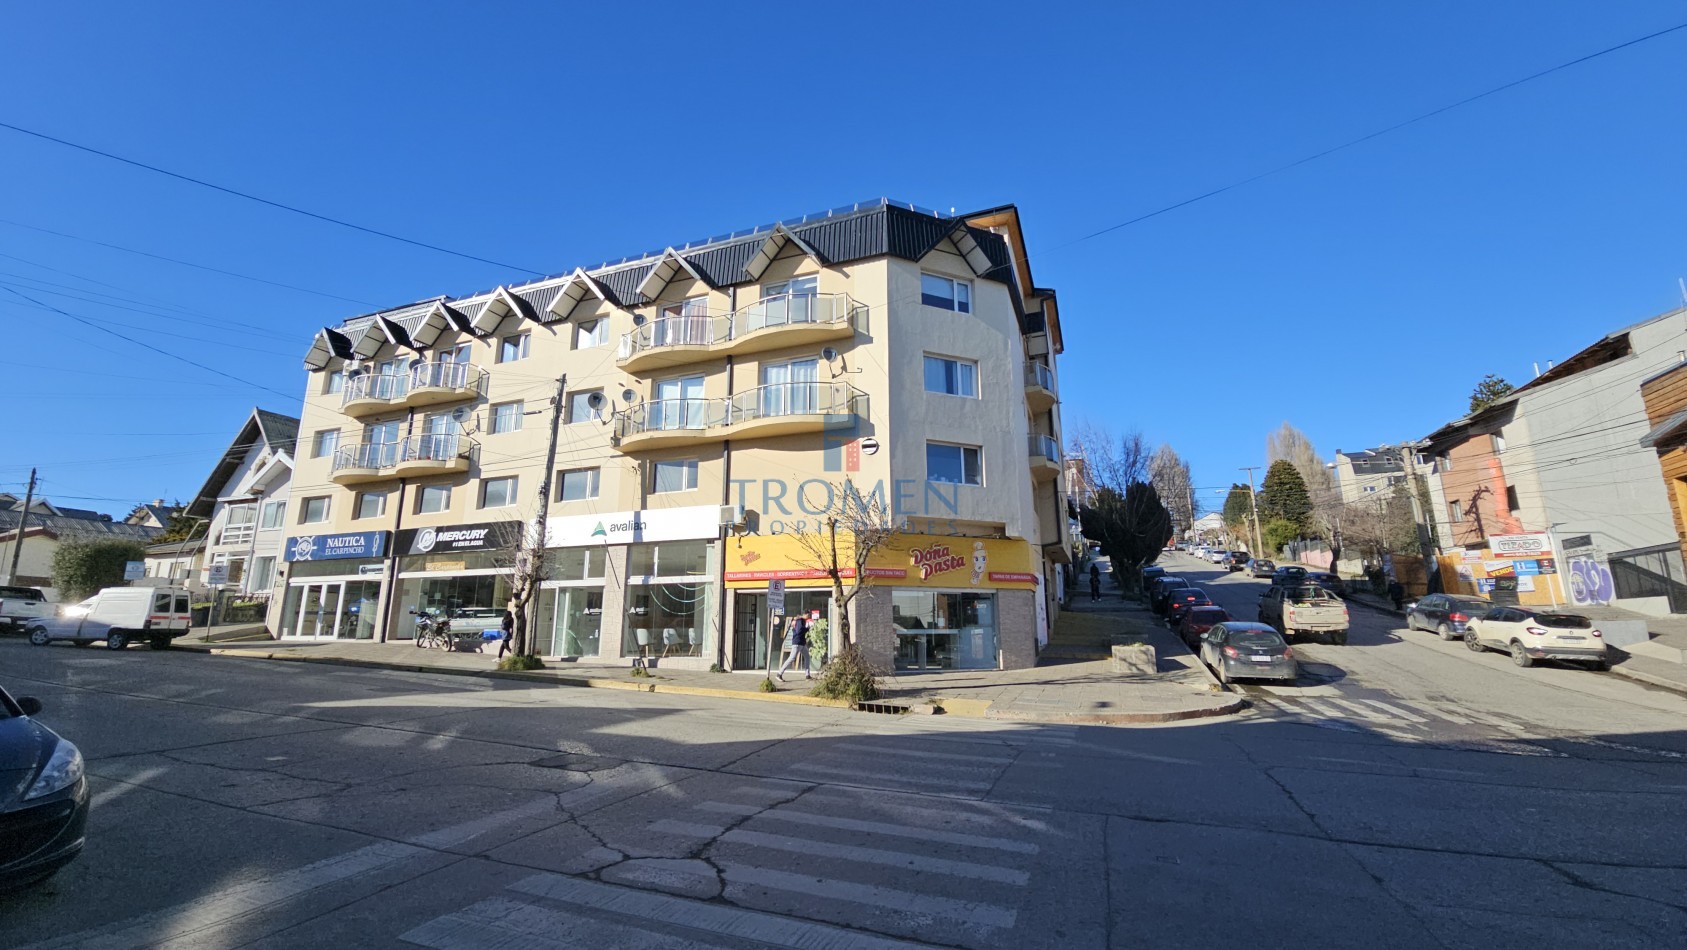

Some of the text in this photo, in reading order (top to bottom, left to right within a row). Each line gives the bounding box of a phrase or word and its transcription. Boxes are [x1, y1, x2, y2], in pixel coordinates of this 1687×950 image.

[609, 520, 647, 532] avalian
[437, 528, 489, 541] MERCURY
[325, 535, 365, 547] NAUTICA
[332, 546, 365, 555] CARPINCHO
[911, 544, 950, 565] Doña
[1490, 567, 1514, 577] VENDE
